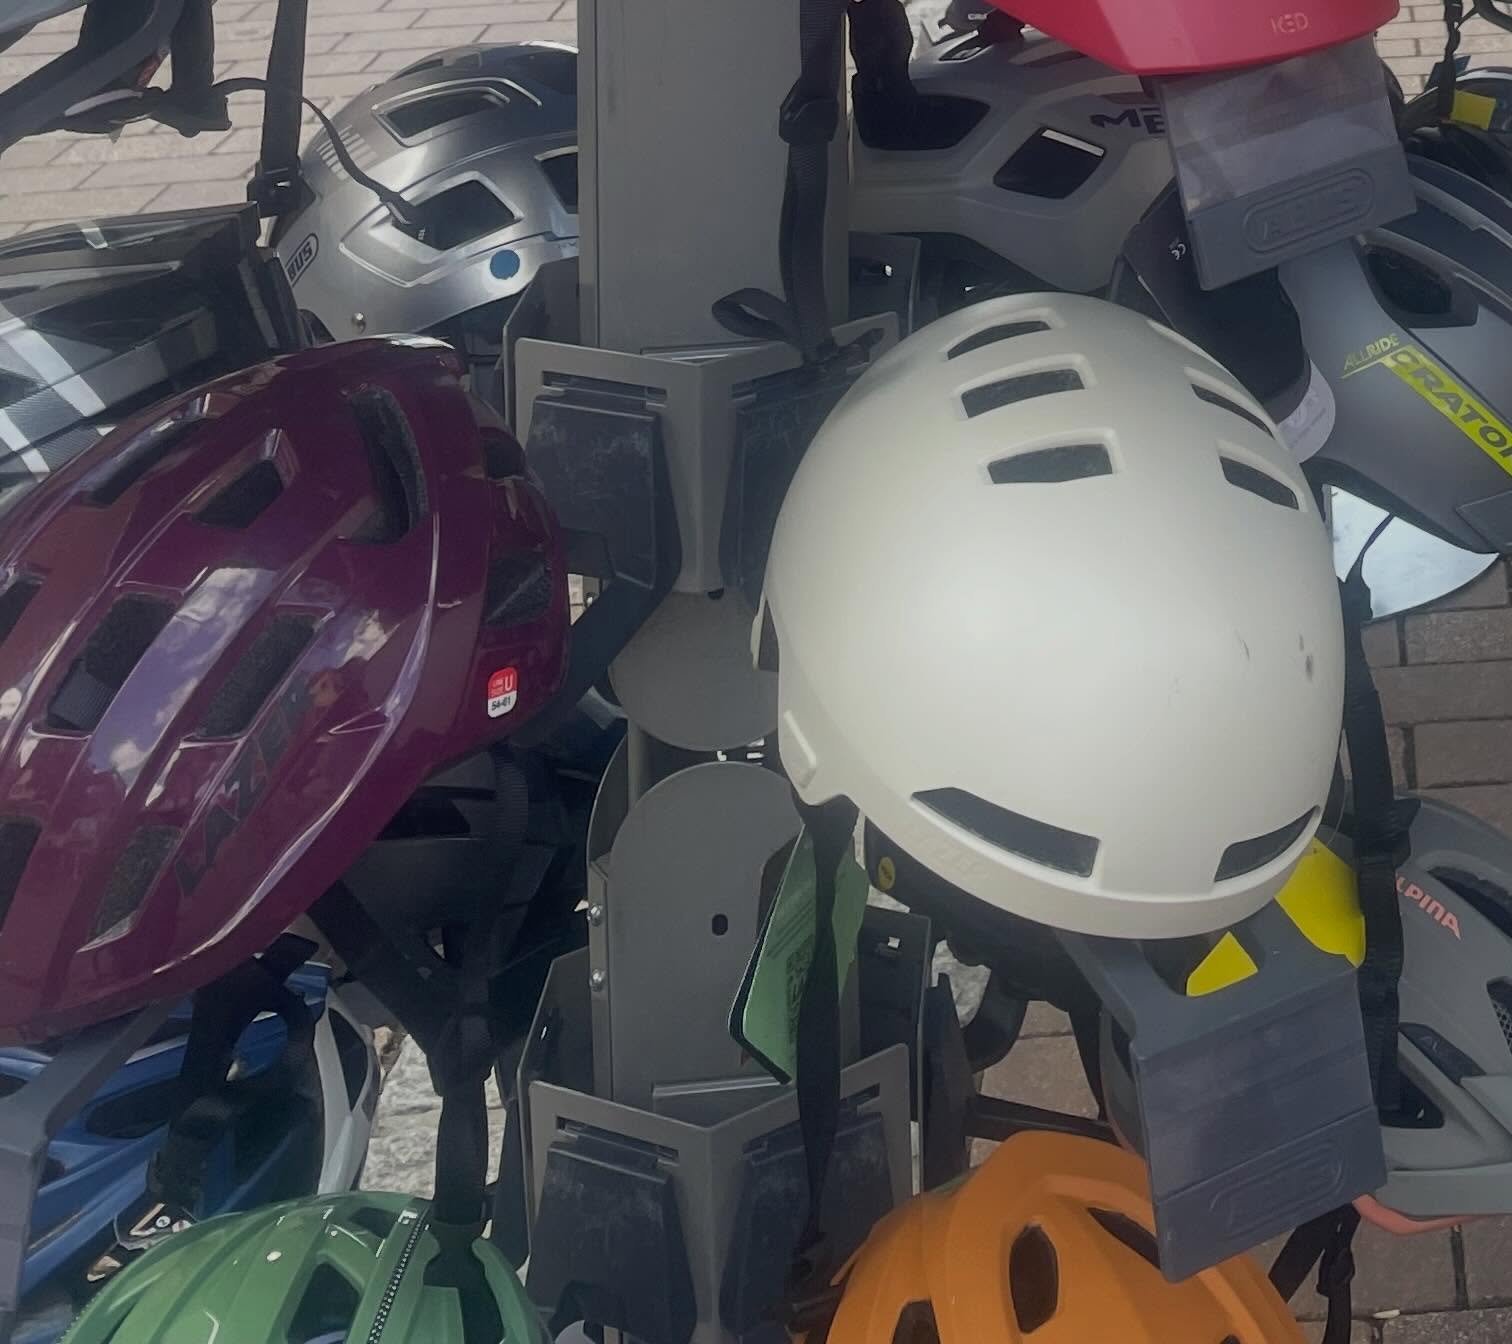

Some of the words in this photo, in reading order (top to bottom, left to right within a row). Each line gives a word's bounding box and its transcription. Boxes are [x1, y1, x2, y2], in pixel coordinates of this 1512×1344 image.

[1270, 12, 1309, 35] KED
[1090, 106, 1166, 135] ME
[286, 240, 313, 283] BUS
[1344, 332, 1400, 370] ALLRIDE
[1396, 877, 1461, 941] LPINA
